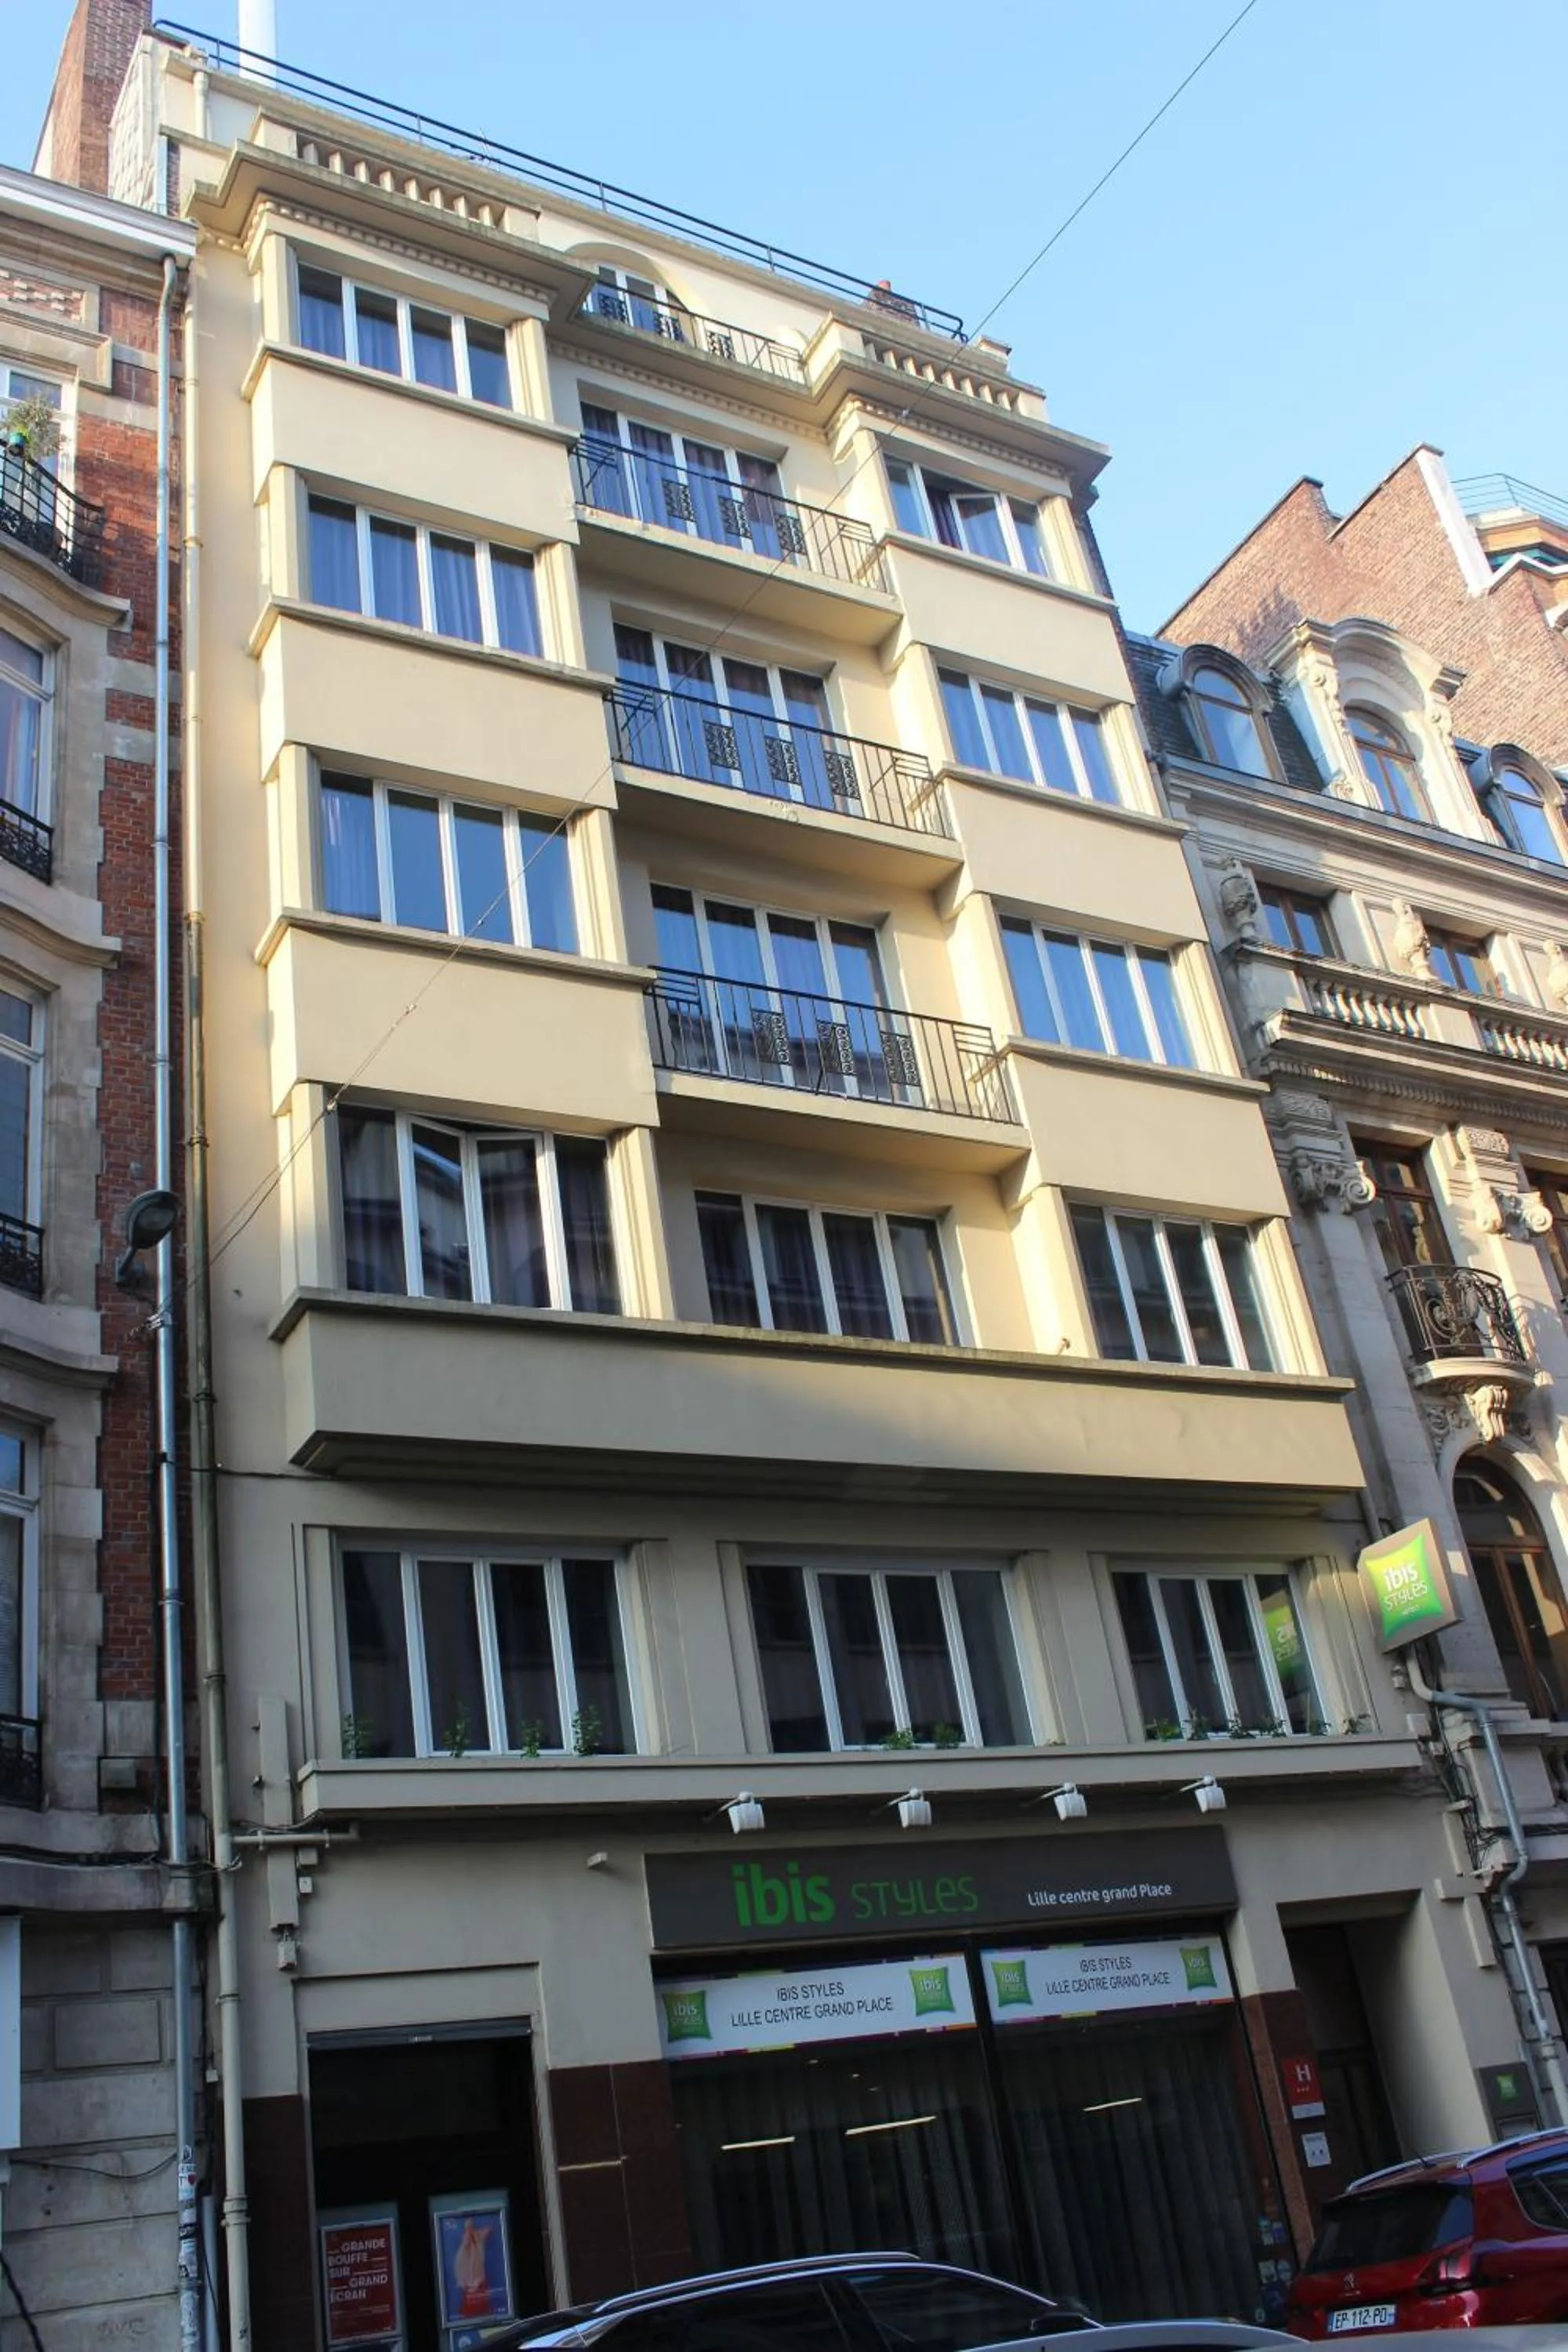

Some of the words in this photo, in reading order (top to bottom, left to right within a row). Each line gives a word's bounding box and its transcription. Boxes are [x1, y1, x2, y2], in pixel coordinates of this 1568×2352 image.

[1384, 1563, 1417, 1592] ibis
[731, 1861, 835, 1926] ibis
[1028, 1890, 1057, 1906] Lille
[1058, 1889, 1099, 1904] centre
[1102, 1885, 1136, 1903] grand
[1139, 1883, 1172, 1897] Place
[1098, 1956, 1133, 1972] STYLES
[802, 1981, 844, 1998] STYLES
[1072, 1975, 1108, 1993] CENTRE
[1109, 1973, 1141, 1990] GRAND
[1142, 1970, 1171, 1985] PLACE
[731, 2010, 762, 2027] LILLE
[764, 2005, 811, 2024] CENTRE
[814, 2001, 855, 2018] GRAND
[857, 1996, 893, 2013] PLACE
[1295, 2064, 1312, 2082] H
[340, 2238, 387, 2252] GRANDE
[348, 2274, 389, 2288] GRAND
